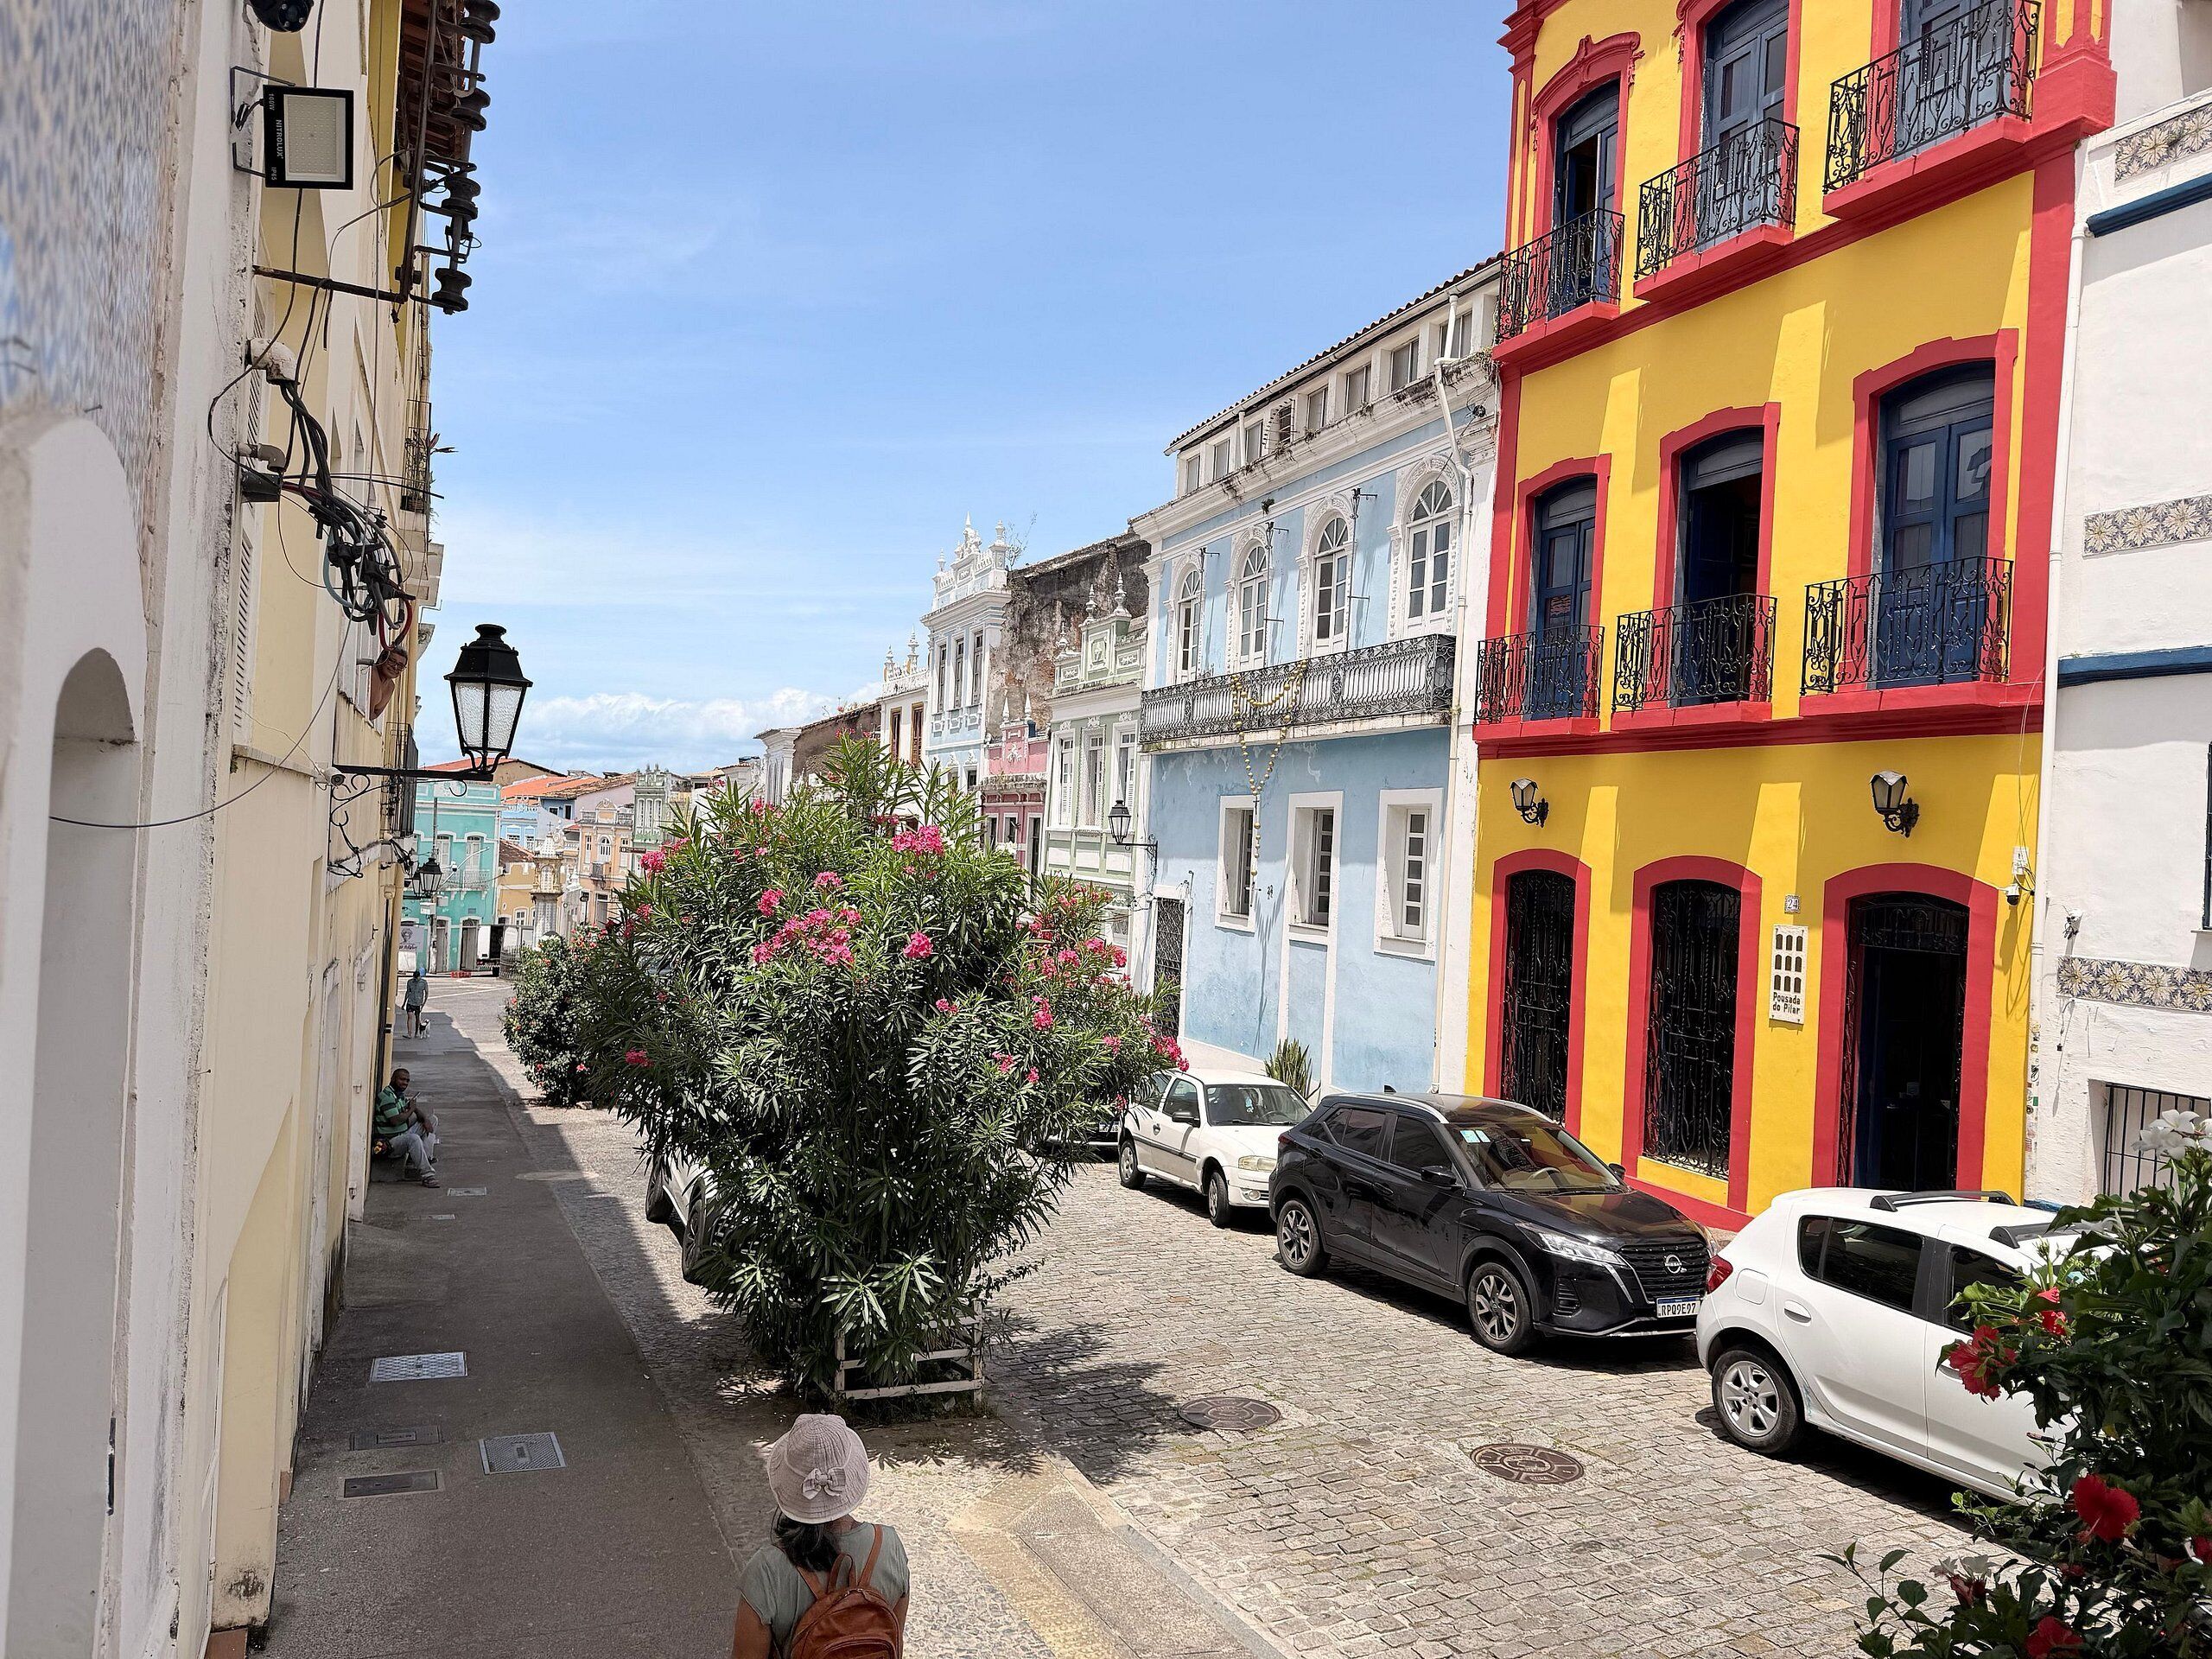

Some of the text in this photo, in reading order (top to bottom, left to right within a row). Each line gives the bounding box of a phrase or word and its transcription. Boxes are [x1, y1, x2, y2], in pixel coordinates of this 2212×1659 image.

[1788, 899, 1798, 910] 24
[1773, 992, 1801, 1005] Pousada
[1772, 1001, 1801, 1014] do Pilar
[1662, 1303, 1696, 1316] RPQ9E97
